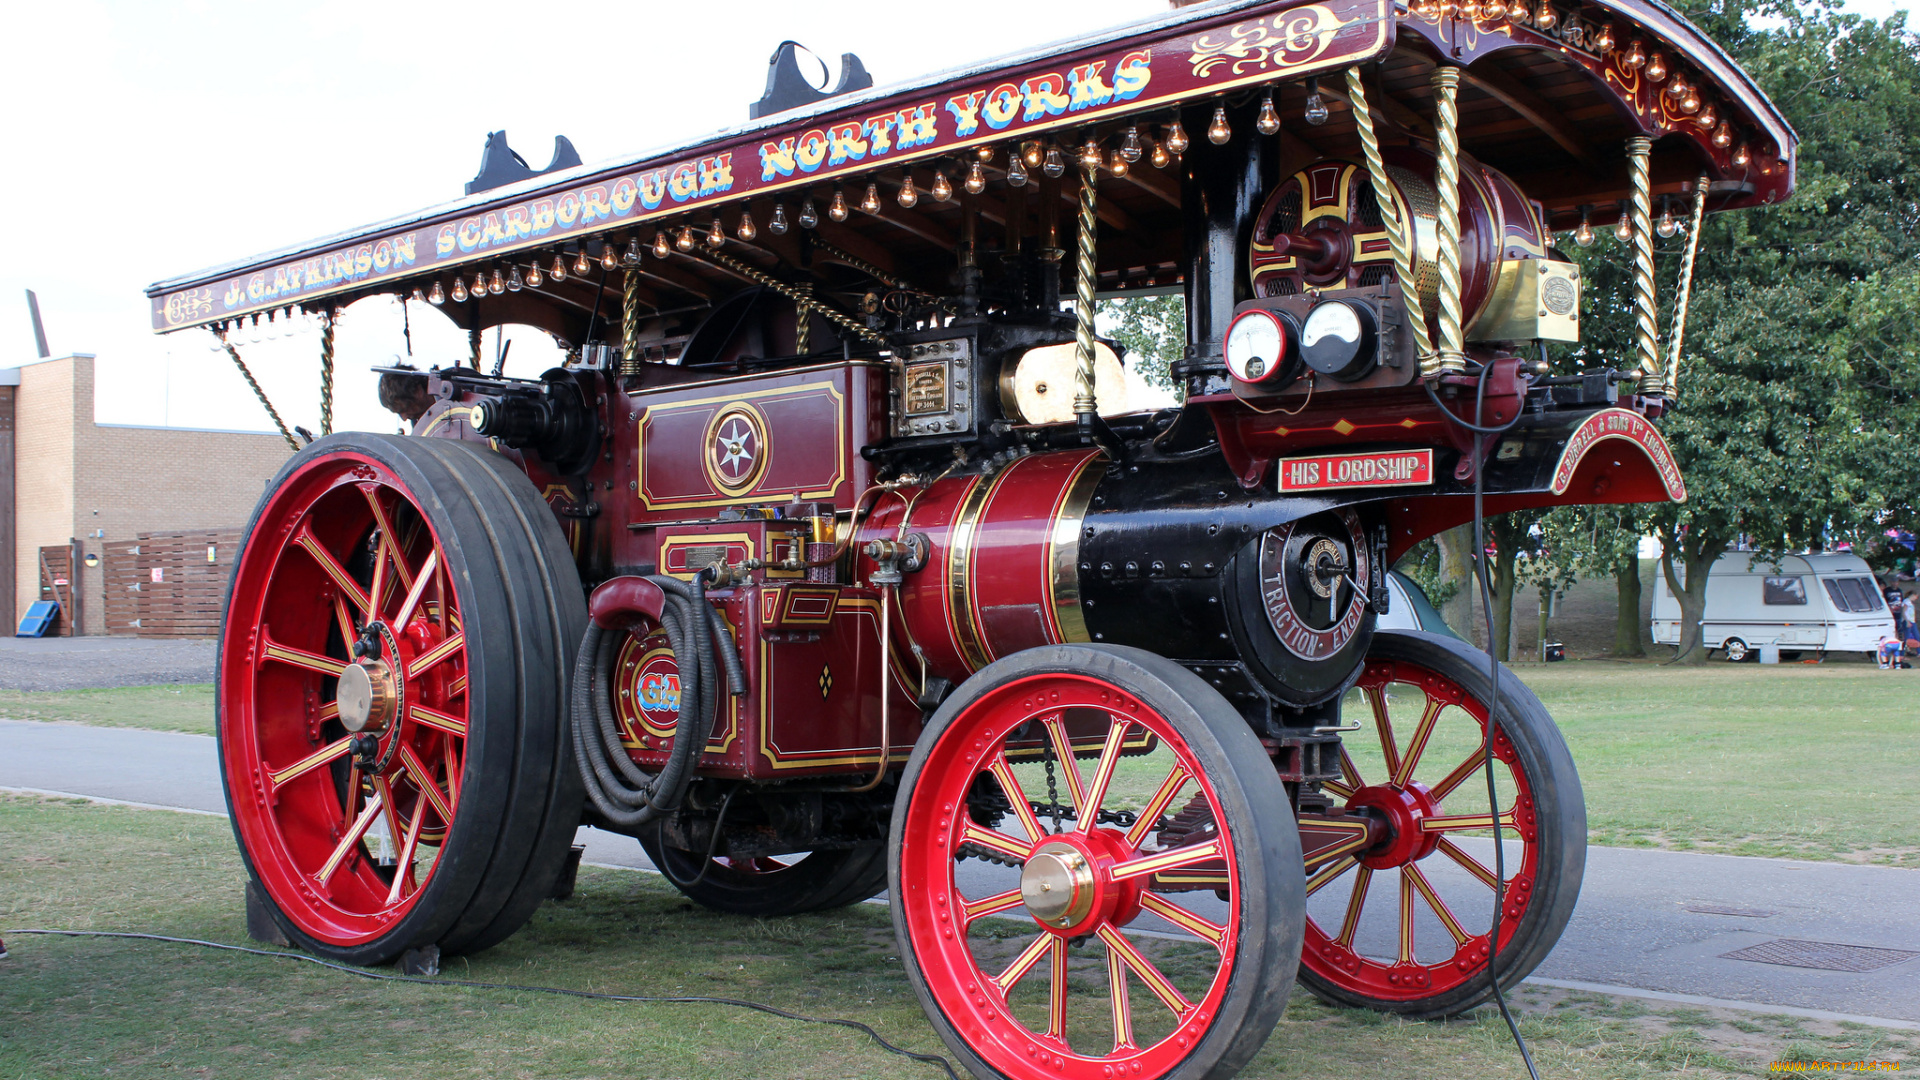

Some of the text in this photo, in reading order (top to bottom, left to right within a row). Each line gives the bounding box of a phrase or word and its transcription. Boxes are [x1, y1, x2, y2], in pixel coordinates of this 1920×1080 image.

[437, 153, 734, 259] SCARBOROUGH
[759, 102, 938, 182] NORTH
[945, 49, 1152, 137] YORKS
[1291, 456, 1419, 486] HIS LORDSHIP
[1565, 423, 1597, 471] BURRELL
[1599, 418, 1605, 433] &
[1607, 415, 1629, 431] SONS
[1643, 430, 1680, 491] ENGINEERS
[1264, 572, 1319, 656] TRACTION
